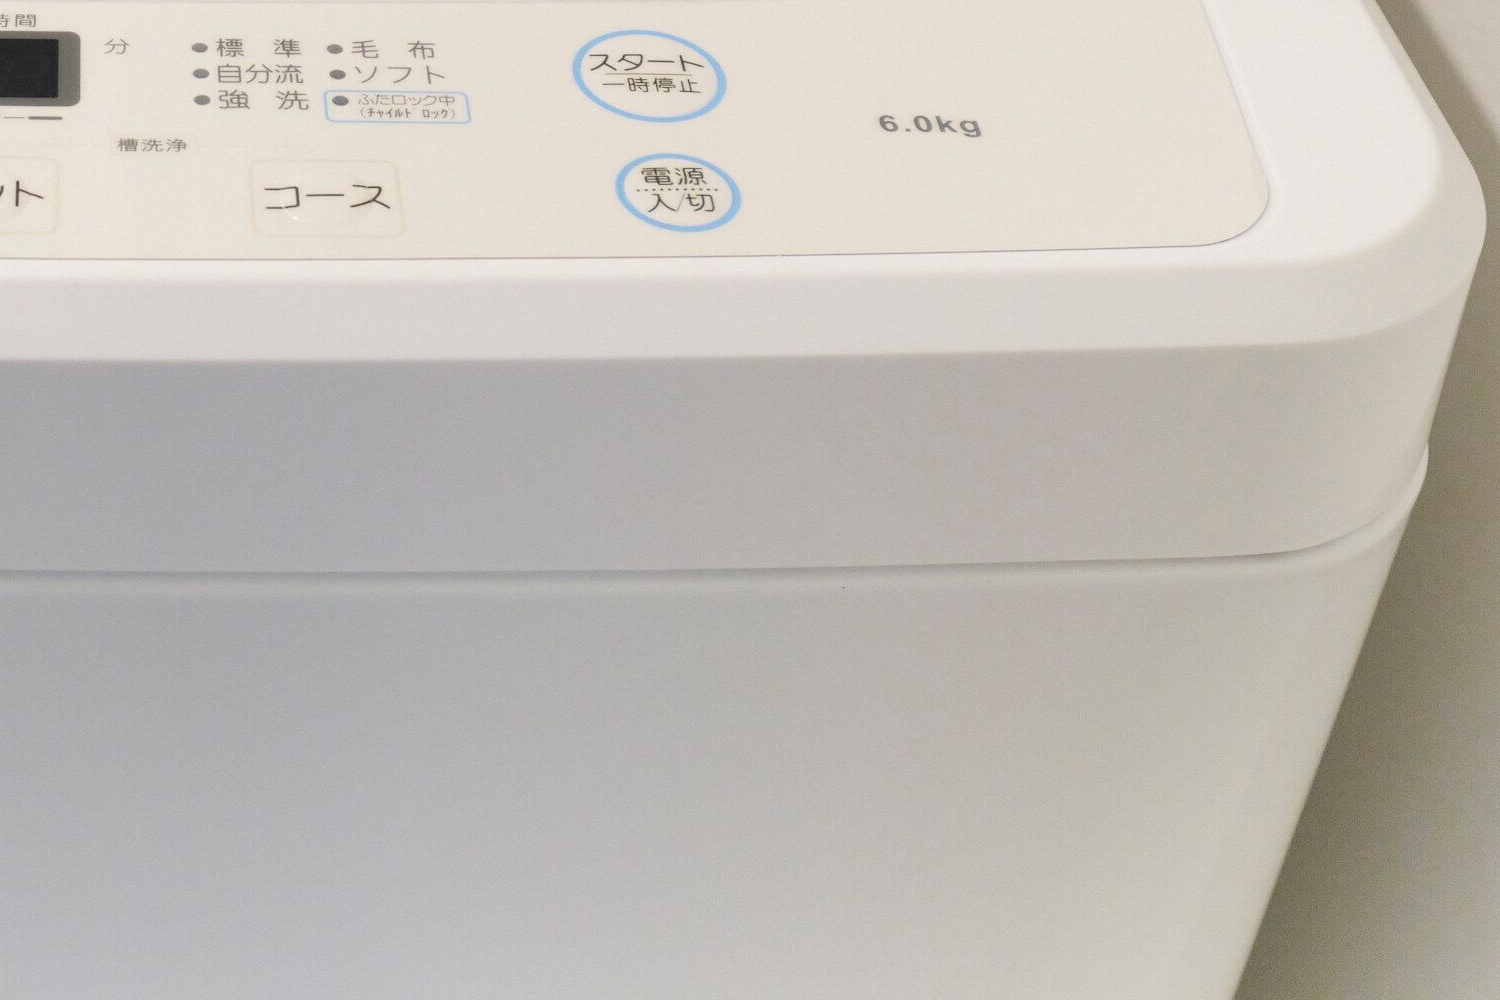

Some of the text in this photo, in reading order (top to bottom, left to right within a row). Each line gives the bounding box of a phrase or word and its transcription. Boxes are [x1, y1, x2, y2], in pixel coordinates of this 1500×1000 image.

[103, 38, 130, 55] 分
[215, 37, 302, 59] 標準
[350, 39, 436, 61] 毛布
[588, 53, 705, 72] スタート
[216, 63, 304, 84] 自分流
[354, 64, 446, 85] ソフト
[601, 76, 702, 94] 一時停止
[218, 89, 310, 111] 強洗
[357, 93, 456, 108] ふたロック中
[878, 114, 982, 138] 6.0kg
[116, 137, 188, 153] 槽洗浄
[640, 167, 708, 186] 電源
[264, 184, 391, 210] コース
[647, 192, 716, 213] 入/切
